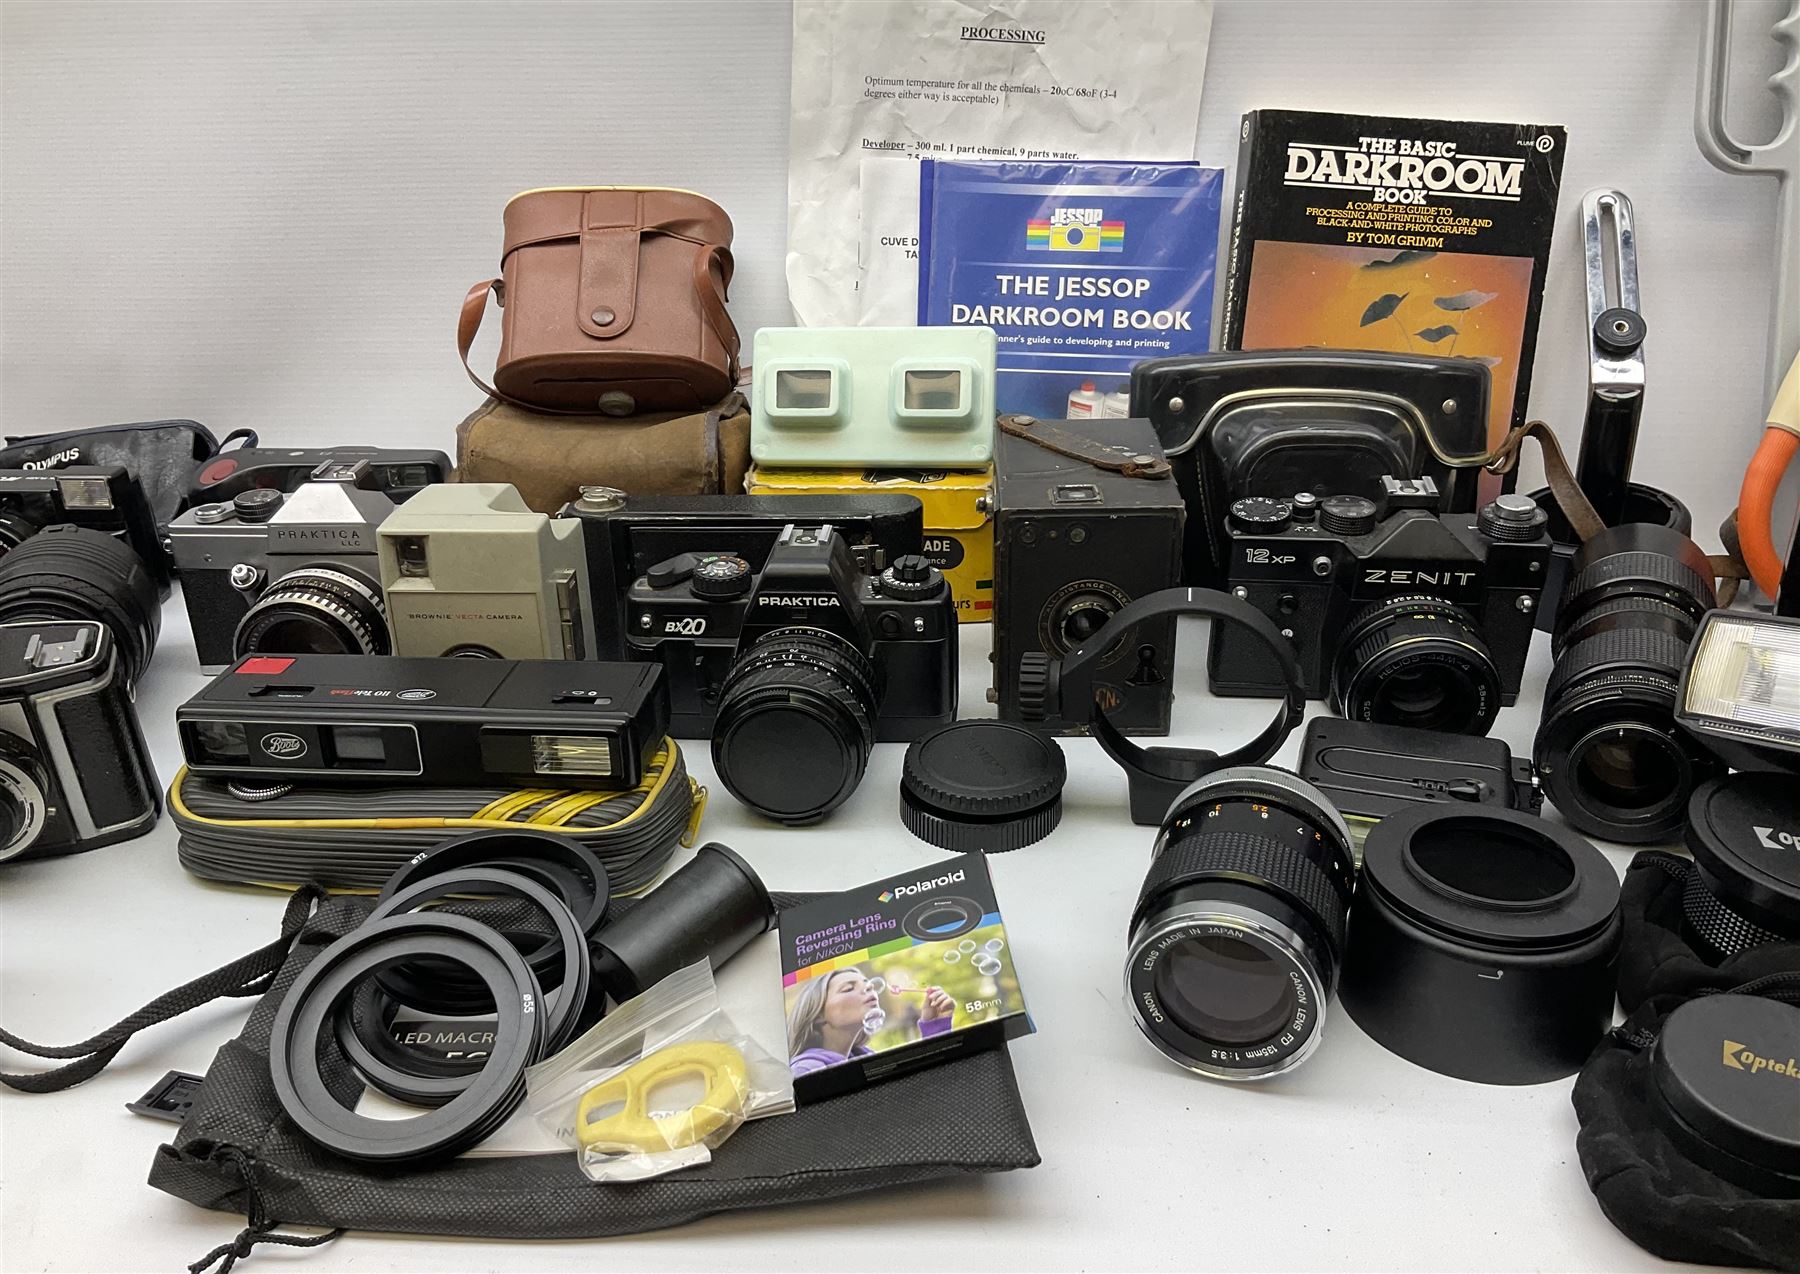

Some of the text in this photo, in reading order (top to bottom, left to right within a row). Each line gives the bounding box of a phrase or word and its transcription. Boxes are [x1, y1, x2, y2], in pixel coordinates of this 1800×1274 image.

[961, 26, 1046, 44] PROCESSING
[864, 76, 904, 87] Optimum
[906, 78, 955, 91] temperature
[957, 80, 970, 89] for
[971, 81, 982, 90] all
[984, 81, 997, 91] the
[999, 82, 1041, 94] chemicals
[1050, 86, 1098, 98] 20oC/68oF
[864, 89, 999, 105] degrees either way is acceptable)
[861, 138, 906, 151] Developer
[915, 141, 931, 151] 300
[933, 142, 947, 152] ml.
[956, 144, 975, 155] part
[977, 145, 1017, 157] chemical,
[1019, 147, 1026, 156] 9
[1027, 149, 1050, 160] parts
[1052, 150, 1079, 160] water.
[1358, 136, 1456, 158] THE BASIC
[1286, 148, 1525, 195] DARKROOM
[1372, 187, 1428, 206] BOOK
[1050, 208, 1103, 226] JESSOP
[1345, 202, 1453, 216] A COMPLETE GUIDE TO
[1306, 208, 1493, 228] PROCESSING AND PRINTING COLOR AND
[1316, 217, 1477, 236] BLACK-AND-WHITE PHOTOGRAPHS
[880, 237, 919, 246] CUVE D
[1346, 232, 1444, 248] BY TOM GRIMM
[905, 250, 919, 259] TA
[996, 275, 1151, 301] THE JESSOP
[951, 303, 1192, 332] DARKROOM BOOK
[995, 334, 1171, 350] nner's guide to developing and printing
[22, 447, 80, 471] OLYMPUS
[277, 529, 361, 542] PRAKTICA
[341, 539, 361, 547] LLC
[923, 540, 951, 552] ADE
[928, 557, 947, 565] nce
[1245, 548, 1270, 564] 12
[1364, 569, 1477, 586] ZENIT
[1060, 582, 1104, 597] DISTANCE
[758, 596, 841, 607] PRAKTICA
[952, 599, 971, 609] urs
[664, 617, 706, 636] BX20
[269, 738, 301, 754] Boots
[894, 869, 966, 900] Polaroid
[795, 911, 882, 946] Camera Lens
[795, 917, 897, 957] Reversing Ring
[797, 941, 855, 967] for NIKON
[1142, 926, 1244, 1024] CANON LENS MADE IN JAPAN
[1289, 970, 1308, 1005] CANON
[965, 998, 1002, 1014] 58mm
[1292, 1007, 1307, 1032] LENS
[395, 1031, 431, 1045] LED
[1280, 1031, 1295, 1046] FD
[1245, 1044, 1279, 1060] 135mm
